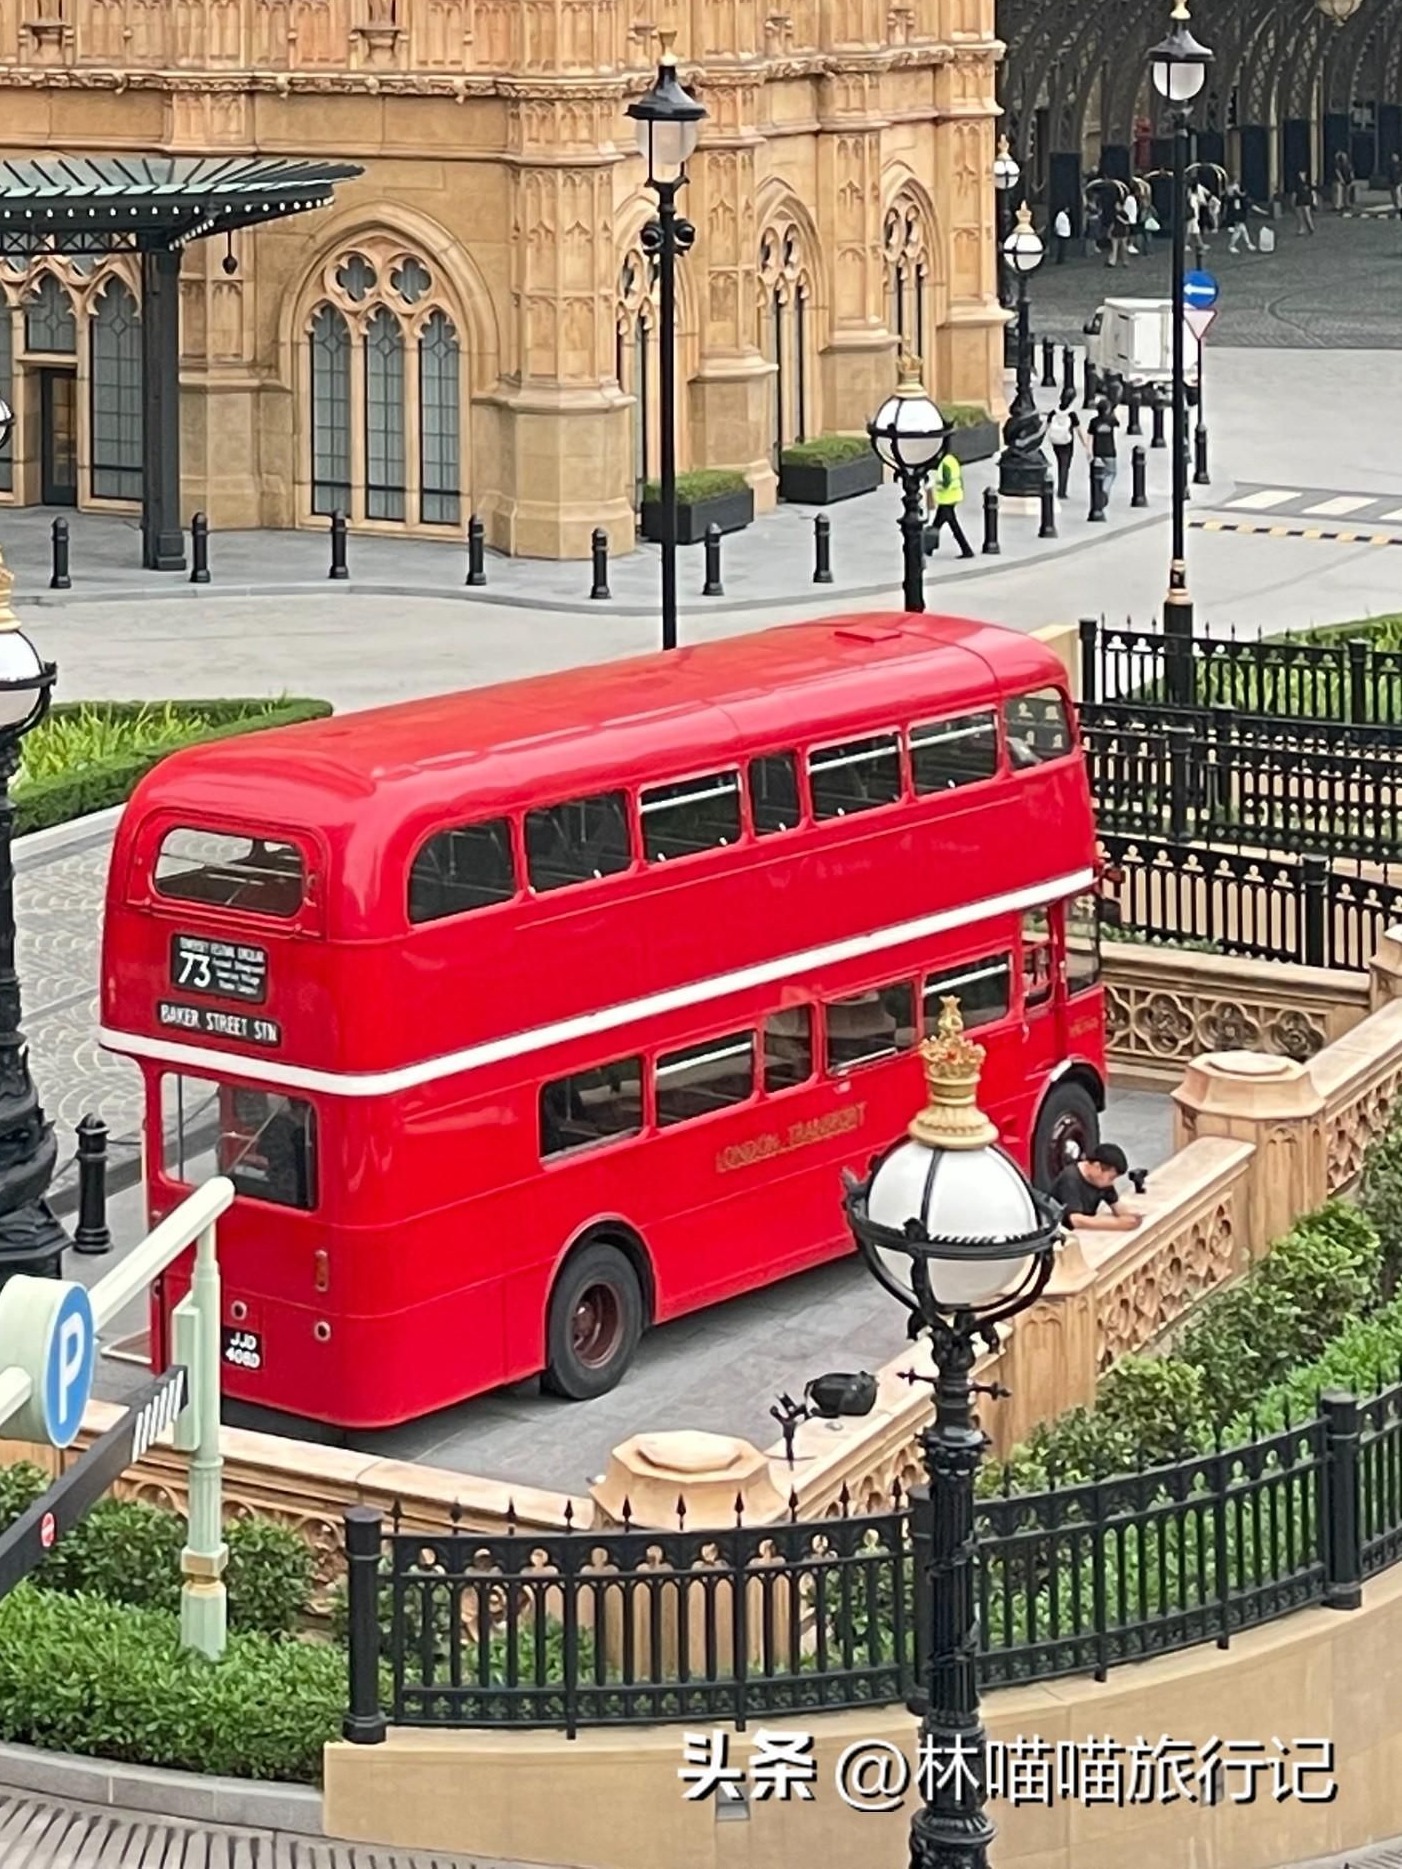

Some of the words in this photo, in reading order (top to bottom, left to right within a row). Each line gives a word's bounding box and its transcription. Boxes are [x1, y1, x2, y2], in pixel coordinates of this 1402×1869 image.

[178, 951, 211, 988] 73
[160, 1004, 200, 1028] BAKER
[205, 1012, 249, 1036] STREET
[253, 1020, 278, 1042] STN
[59, 1312, 85, 1425] P
